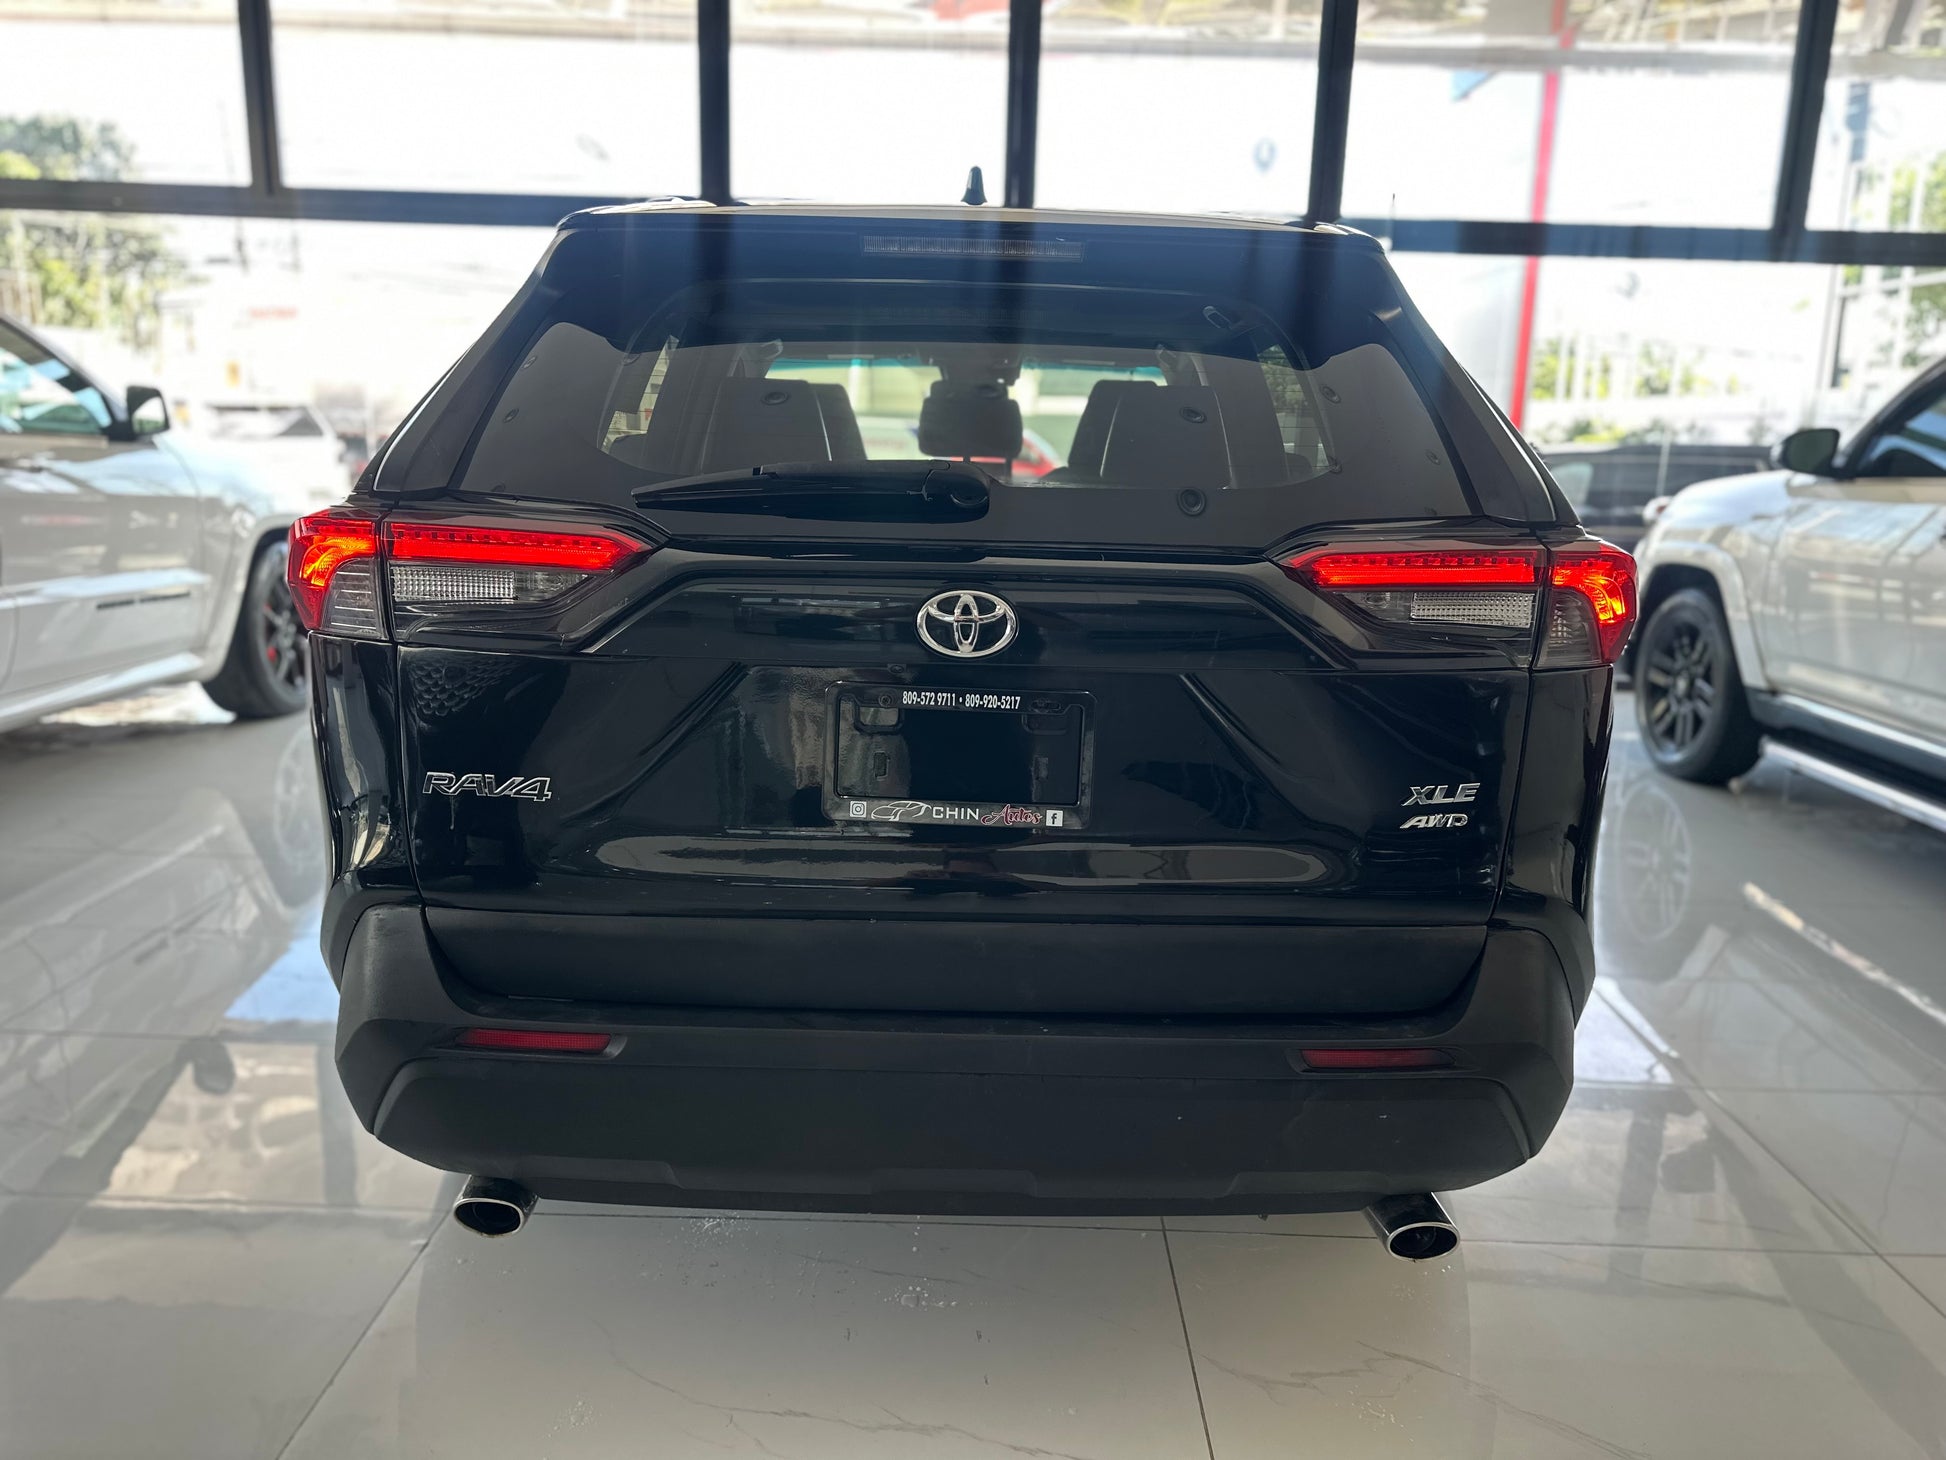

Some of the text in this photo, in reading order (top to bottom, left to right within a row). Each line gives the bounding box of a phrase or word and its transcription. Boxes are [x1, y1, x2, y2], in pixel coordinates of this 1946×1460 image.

[902, 691, 1021, 709] 809-572 9711 809-920-5217
[422, 771, 553, 802] RAV4
[1401, 782, 1481, 807] XLE
[932, 806, 979, 820] CHIN
[980, 804, 1042, 826] Autos
[1400, 813, 1469, 829] AWD
